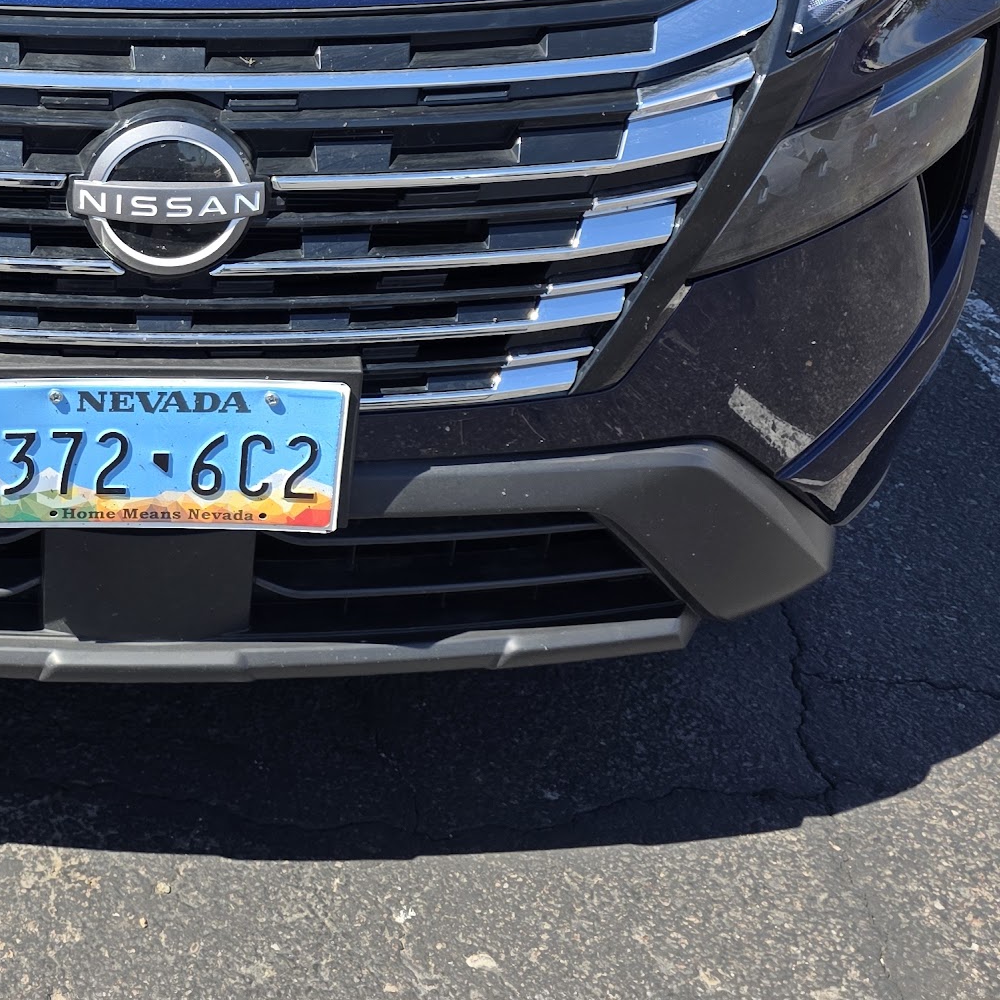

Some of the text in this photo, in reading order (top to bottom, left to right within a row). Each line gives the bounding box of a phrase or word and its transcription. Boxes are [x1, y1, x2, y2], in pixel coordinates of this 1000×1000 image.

[79, 189, 260, 217] NISSAN
[76, 390, 251, 414] NEVADA
[61, 507, 254, 521] Home Means Nevada
